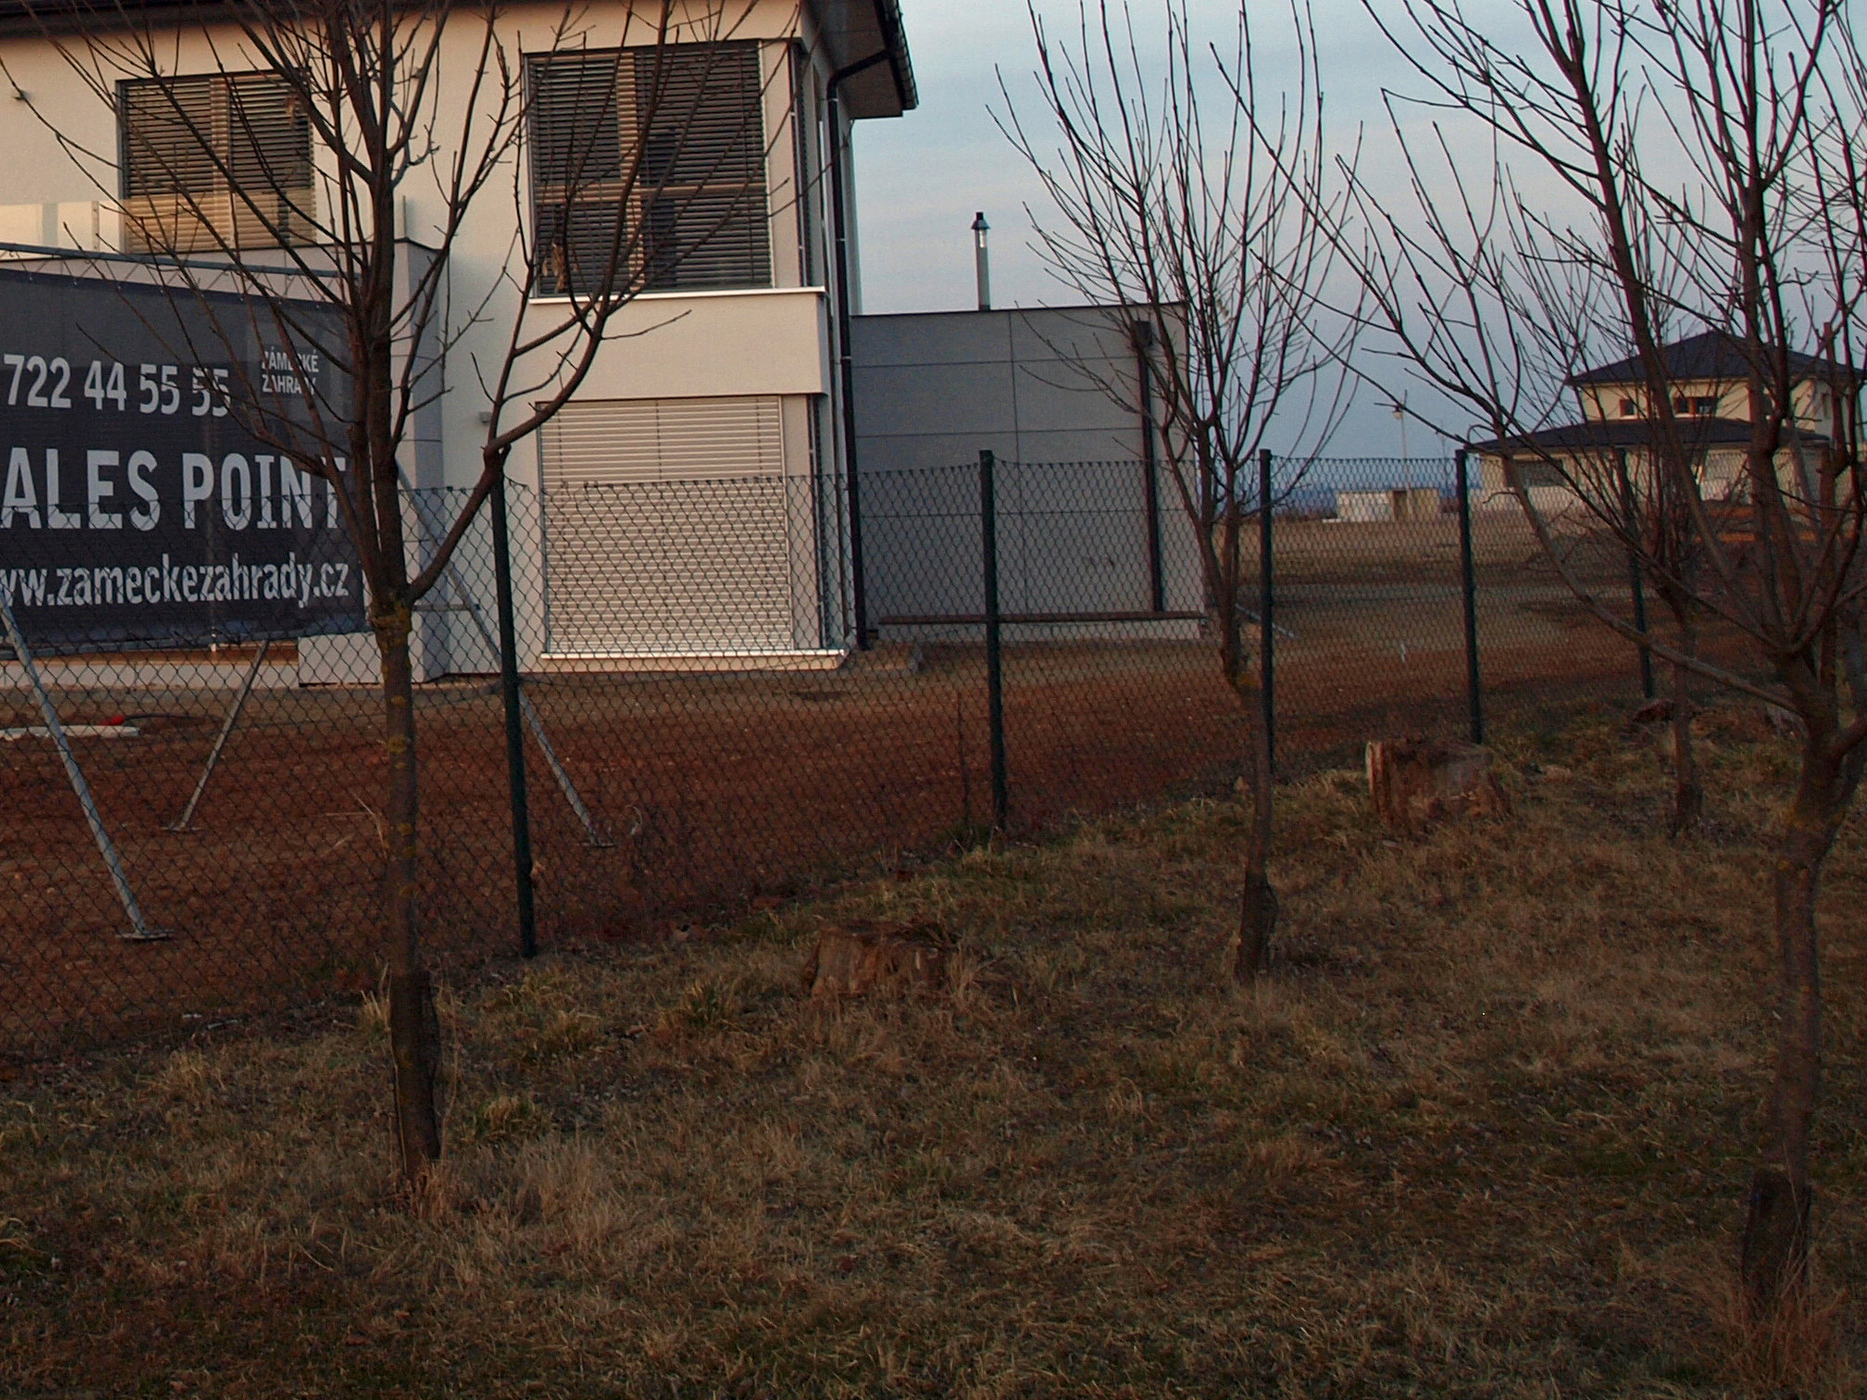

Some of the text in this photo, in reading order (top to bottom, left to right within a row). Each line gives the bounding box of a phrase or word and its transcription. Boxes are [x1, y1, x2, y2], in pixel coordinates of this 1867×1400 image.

[2, 353, 231, 417] 722 44 55 55
[261, 374, 317, 396] ZAHRAY
[182, 452, 347, 531] POINT
